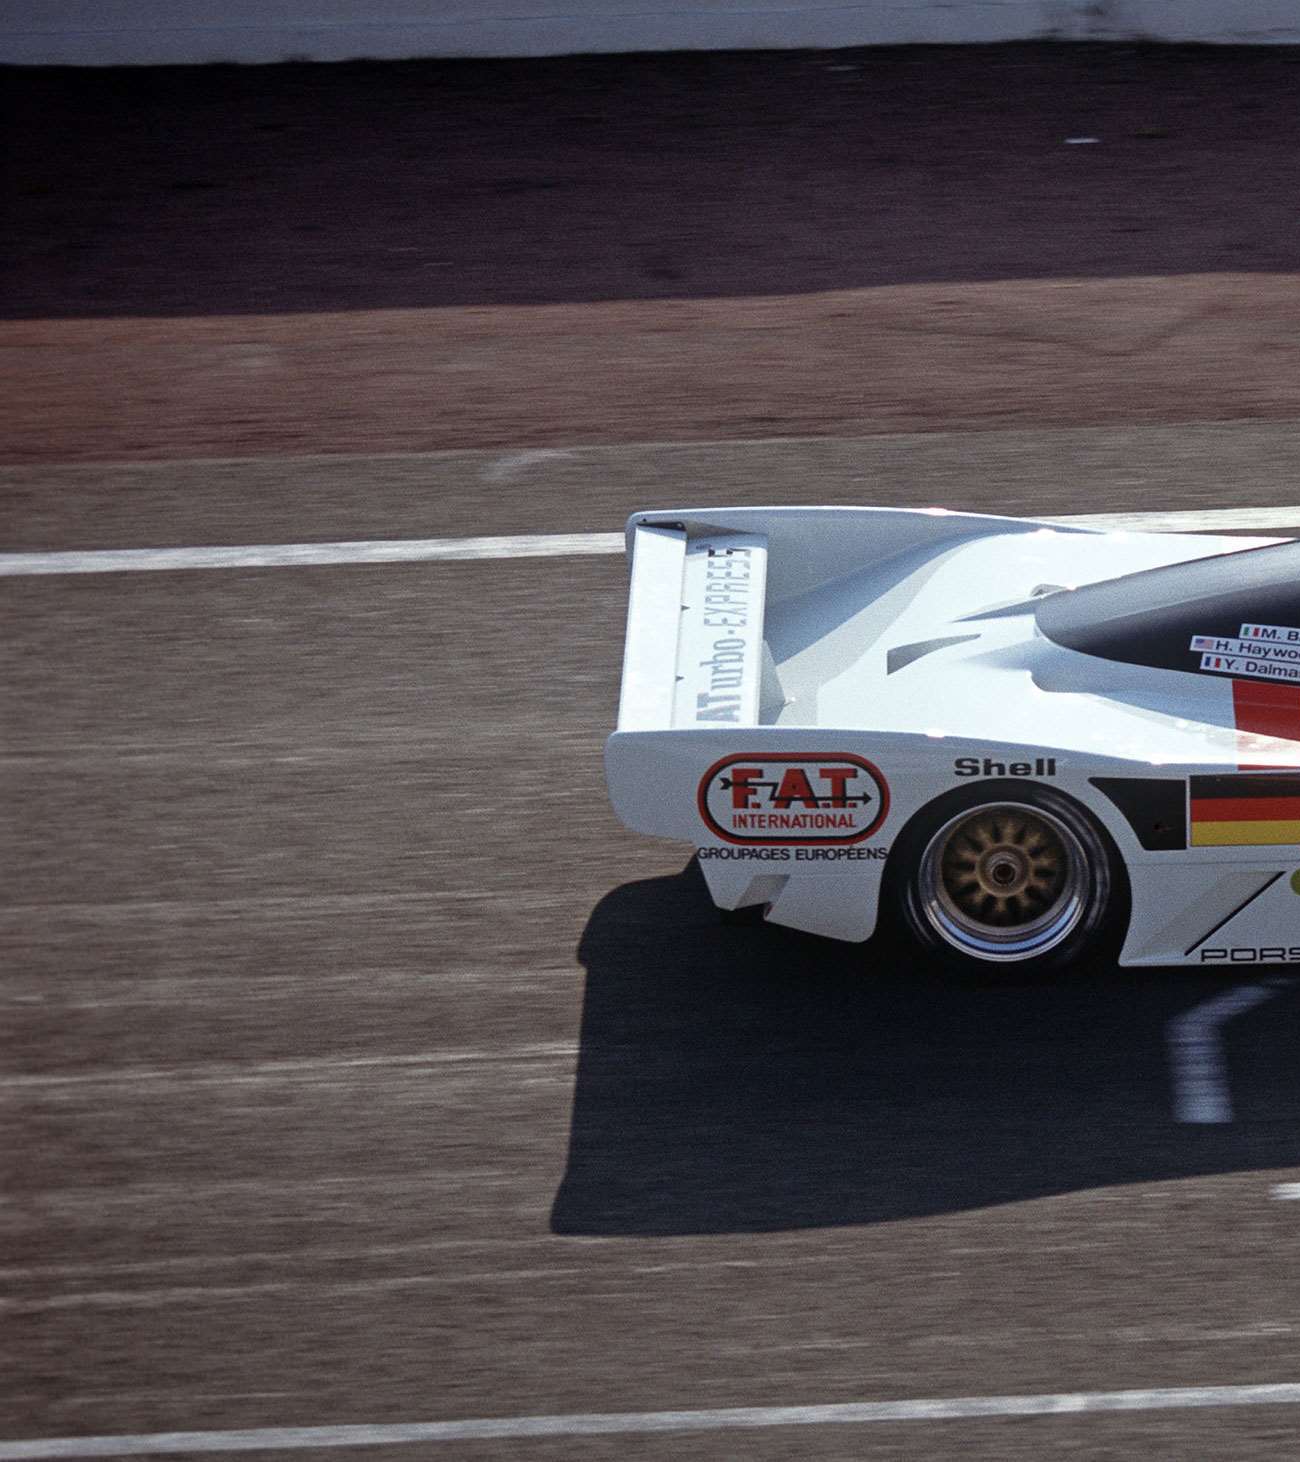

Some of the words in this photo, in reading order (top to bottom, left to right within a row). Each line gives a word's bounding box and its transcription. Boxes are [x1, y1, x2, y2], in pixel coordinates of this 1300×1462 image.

[1261, 628, 1281, 640] M.
[1215, 640, 1233, 652] H.
[1224, 658, 1239, 670] Y.
[954, 757, 1056, 776] Shell
[731, 768, 858, 809] F.A.T.
[732, 813, 857, 829] INTERNATIONAL
[698, 847, 791, 861] GROUPAGES
